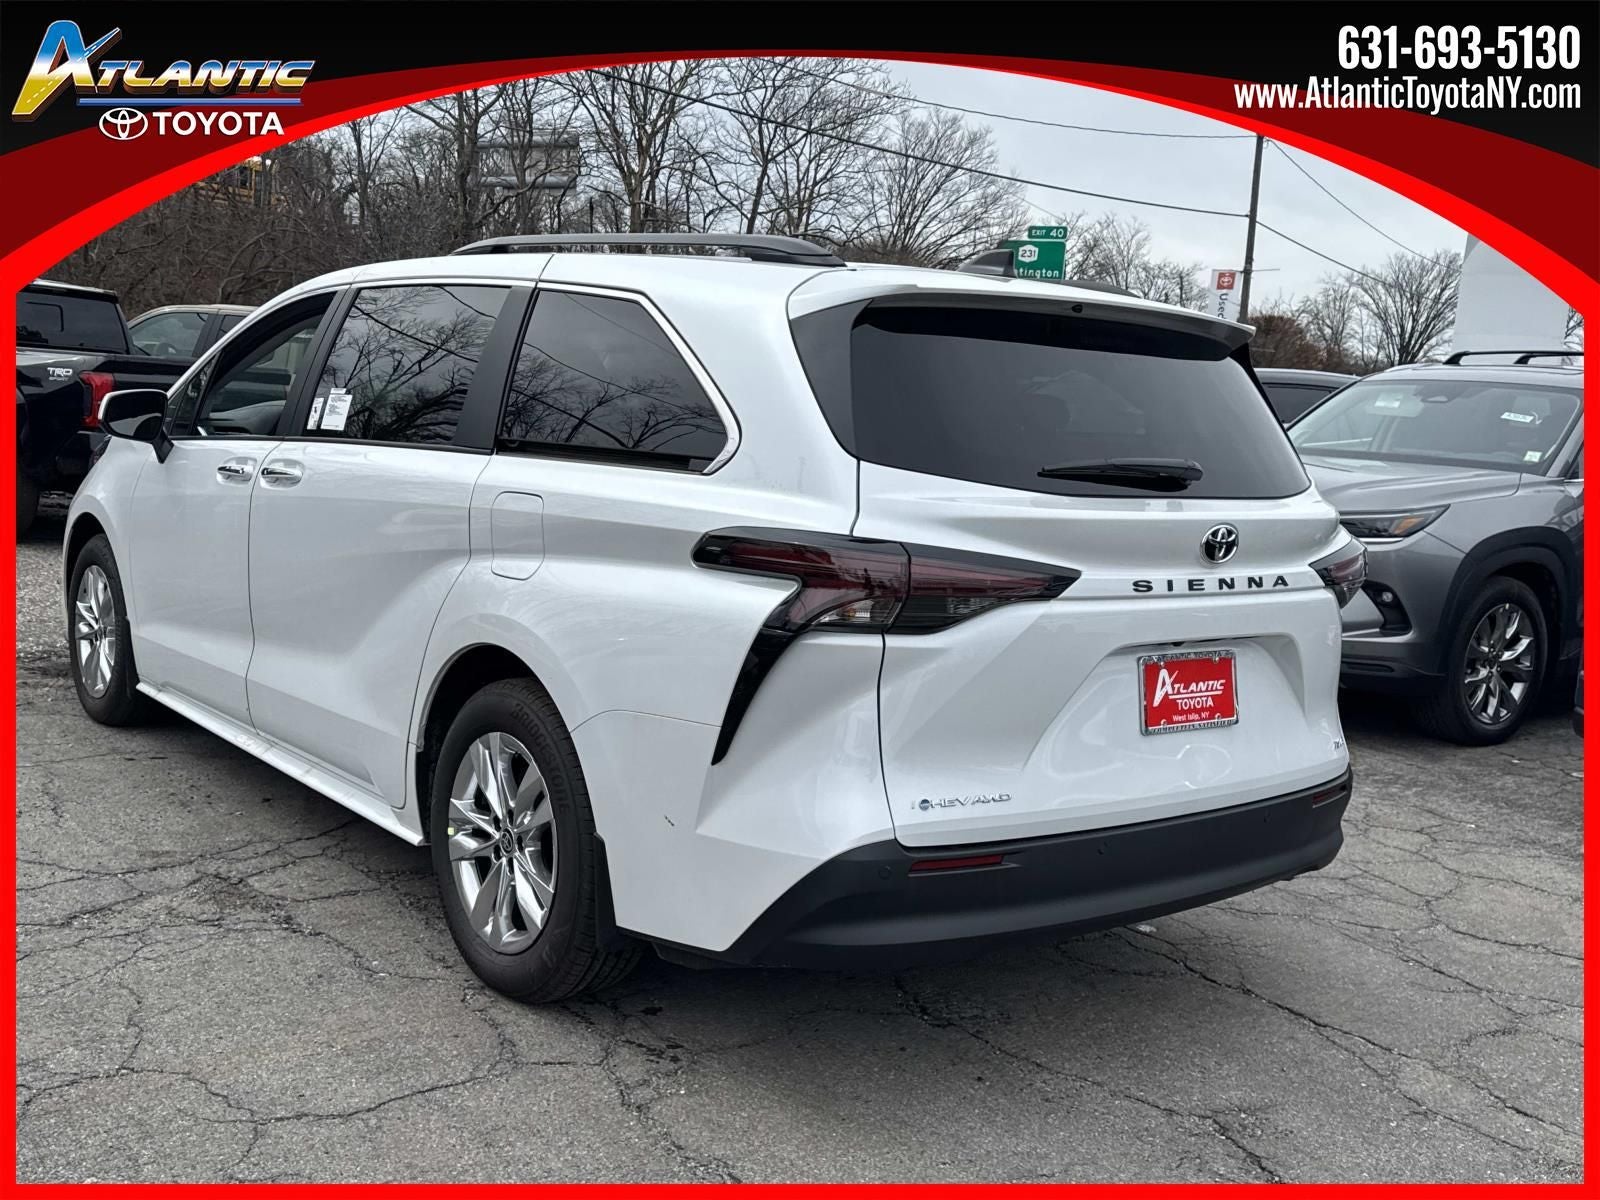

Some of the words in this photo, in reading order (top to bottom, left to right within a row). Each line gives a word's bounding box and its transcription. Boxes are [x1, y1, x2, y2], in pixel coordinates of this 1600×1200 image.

[1049, 228, 1064, 238] 40
[1020, 249, 1037, 258] 231
[1017, 267, 1059, 279] tington
[47, 367, 73, 377] TRD
[1132, 575, 1289, 593] SIENNA
[1152, 668, 1226, 707] ATLANTIC
[1176, 696, 1215, 711] TOYOTA
[1172, 713, 1187, 722] West
[1201, 711, 1210, 719] NY
